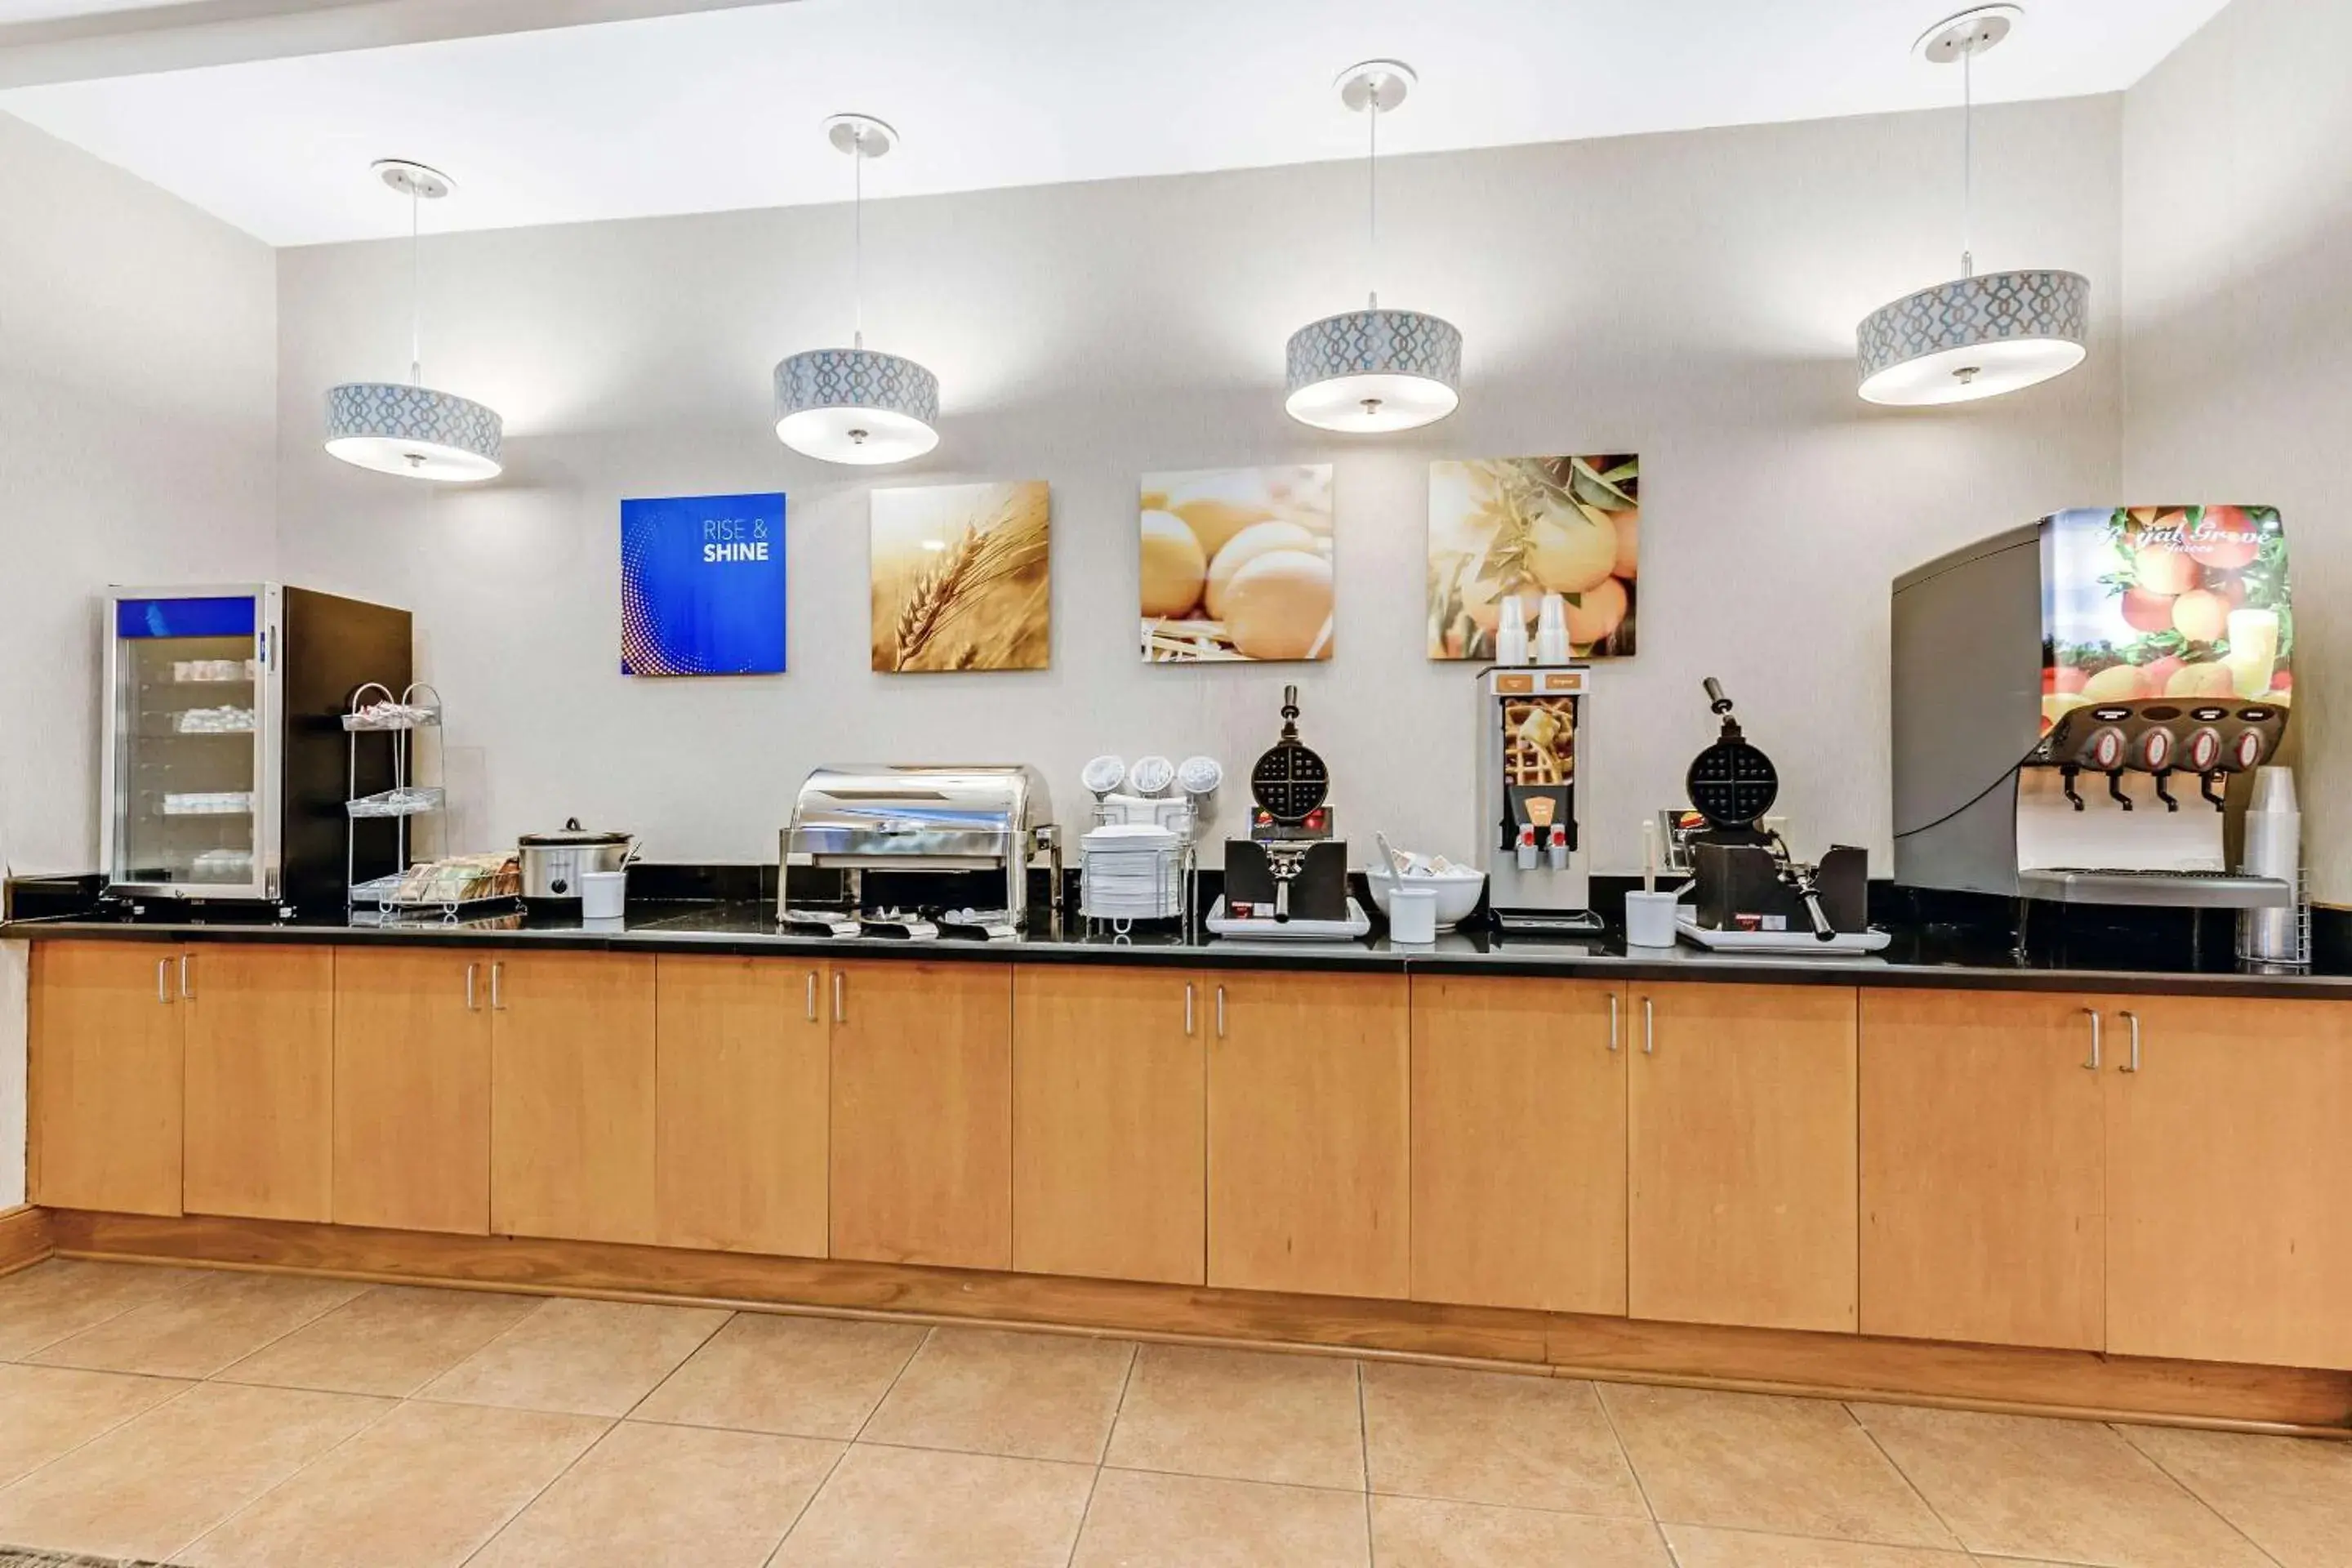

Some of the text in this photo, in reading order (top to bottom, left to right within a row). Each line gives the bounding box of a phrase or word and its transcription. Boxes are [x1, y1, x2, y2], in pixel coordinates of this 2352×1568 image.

[704, 519, 768, 540] RISE &
[2096, 522, 2185, 546] Ryal
[703, 542, 768, 562] SHINE
